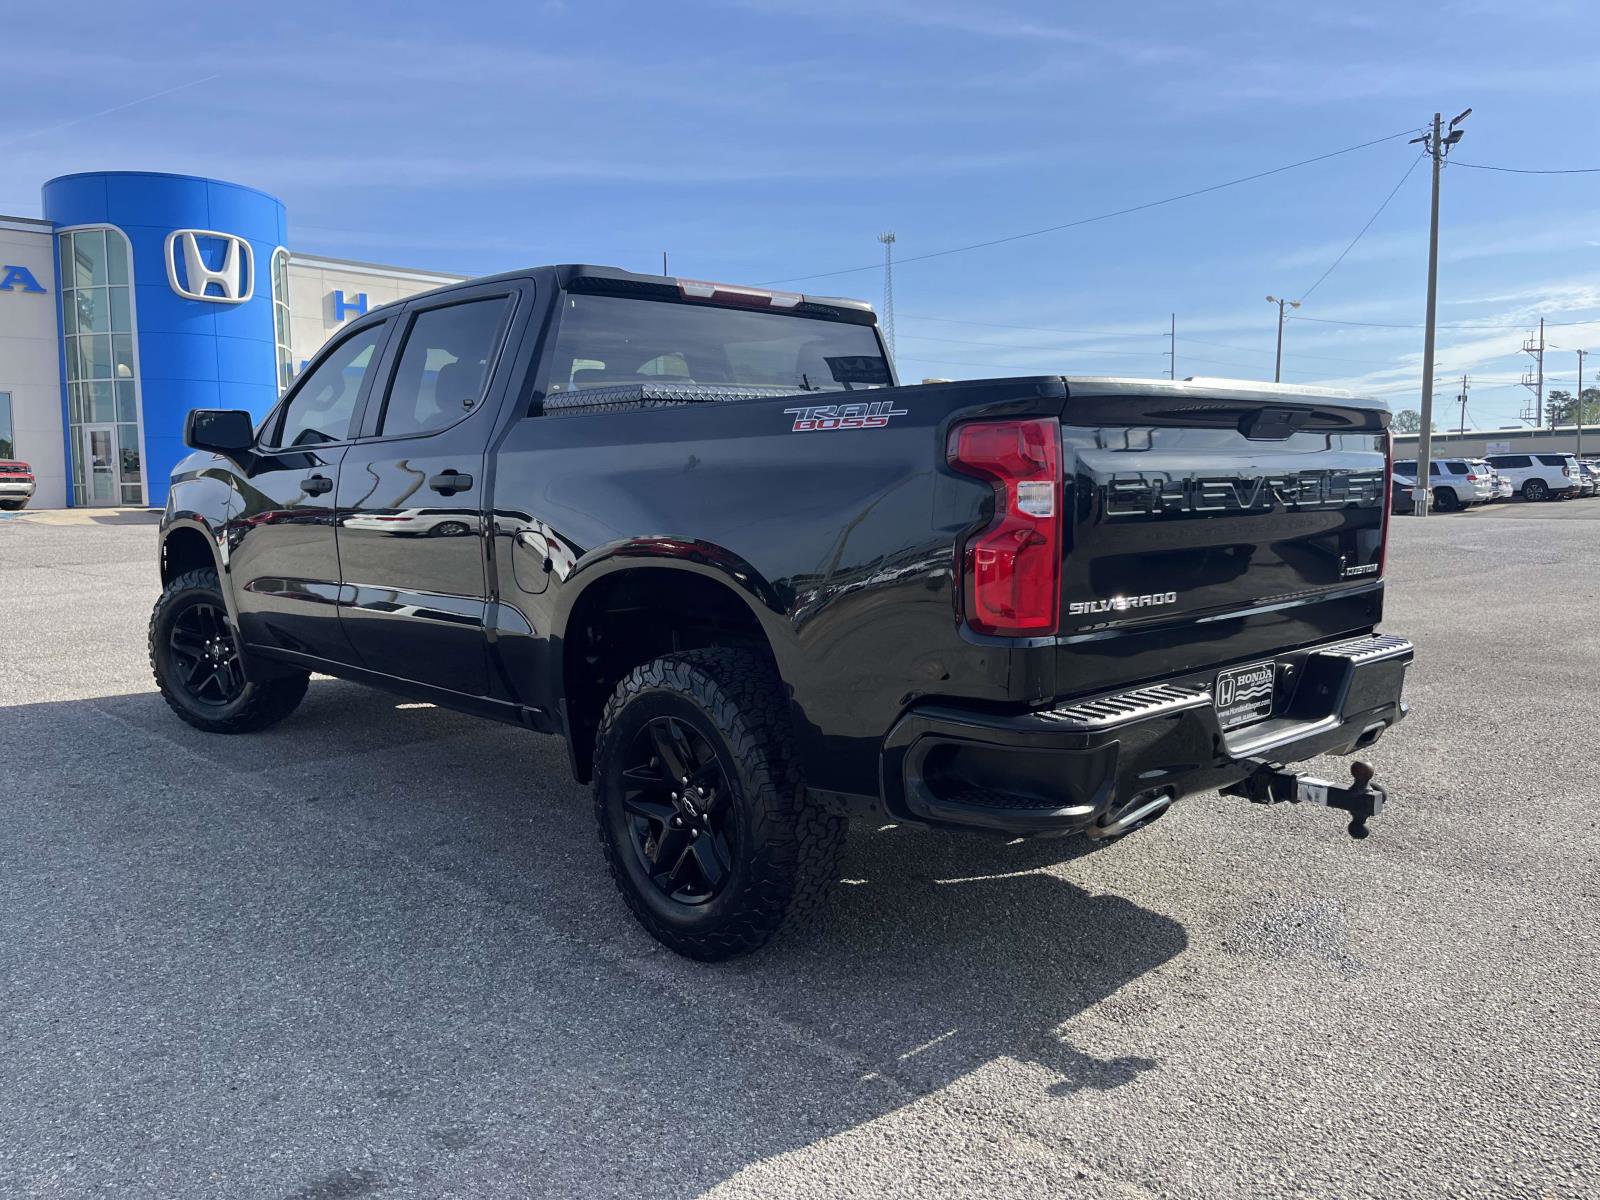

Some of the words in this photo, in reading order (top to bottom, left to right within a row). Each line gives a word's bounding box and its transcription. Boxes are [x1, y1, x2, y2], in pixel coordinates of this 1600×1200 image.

[784, 400, 908, 420] TRAIL
[792, 415, 890, 432] BOSS
[1069, 591, 1177, 615] SILVERADO
[1236, 669, 1272, 686] HONDA
